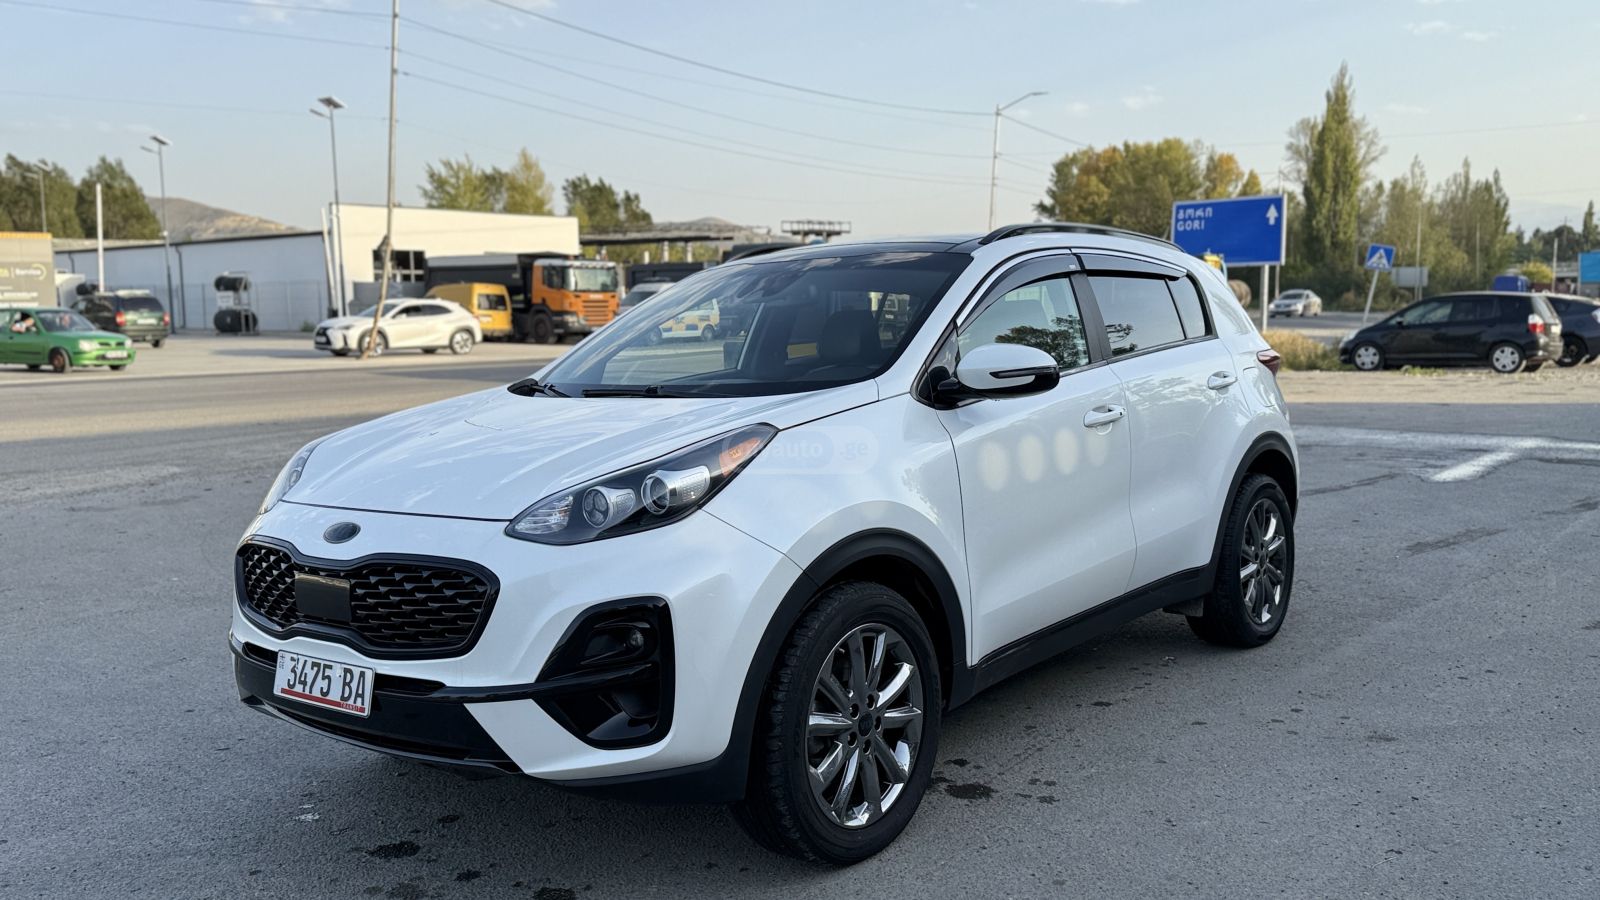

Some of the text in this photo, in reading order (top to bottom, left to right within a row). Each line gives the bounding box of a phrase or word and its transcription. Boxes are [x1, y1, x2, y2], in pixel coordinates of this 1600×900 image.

[1177, 220, 1205, 231] GORI
[287, 656, 366, 706] 3475 BA
